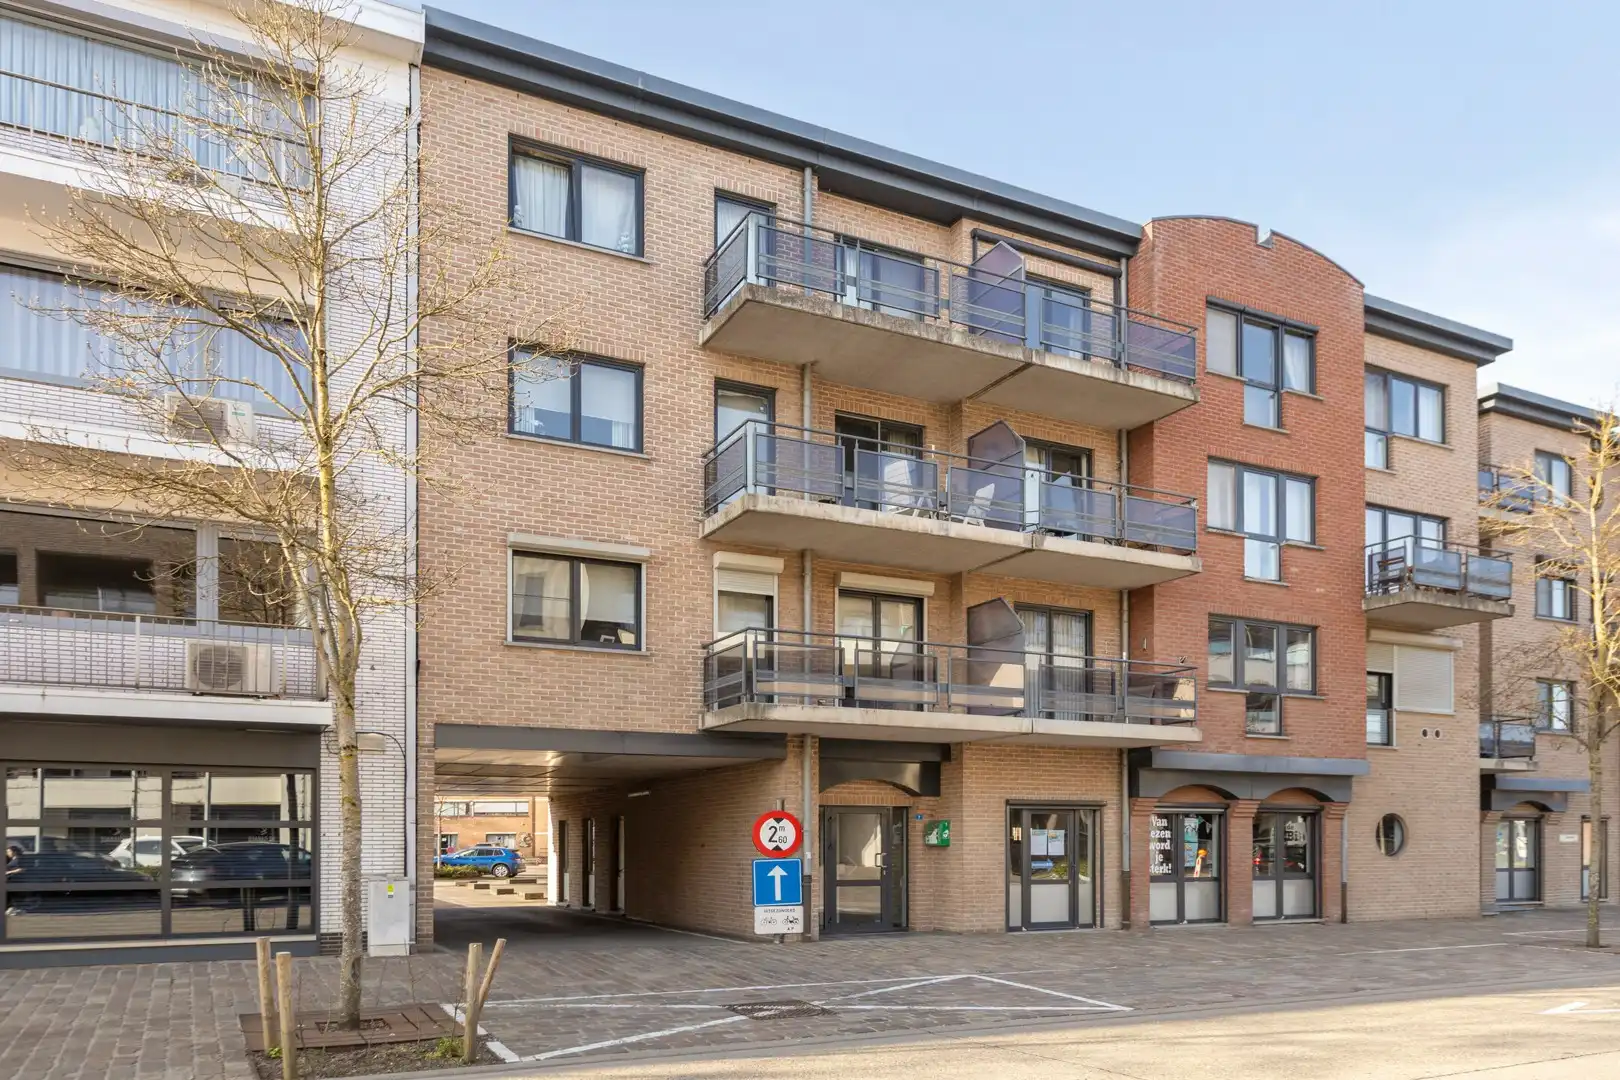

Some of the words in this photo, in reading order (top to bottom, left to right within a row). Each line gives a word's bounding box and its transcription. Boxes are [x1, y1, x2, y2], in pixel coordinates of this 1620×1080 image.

[1151, 816, 1168, 826] Van
[768, 826, 778, 843] 2
[778, 835, 788, 843] 60
[1150, 830, 1171, 838] ezen
[1155, 851, 1164, 864] je
[1149, 863, 1172, 874] terk!
